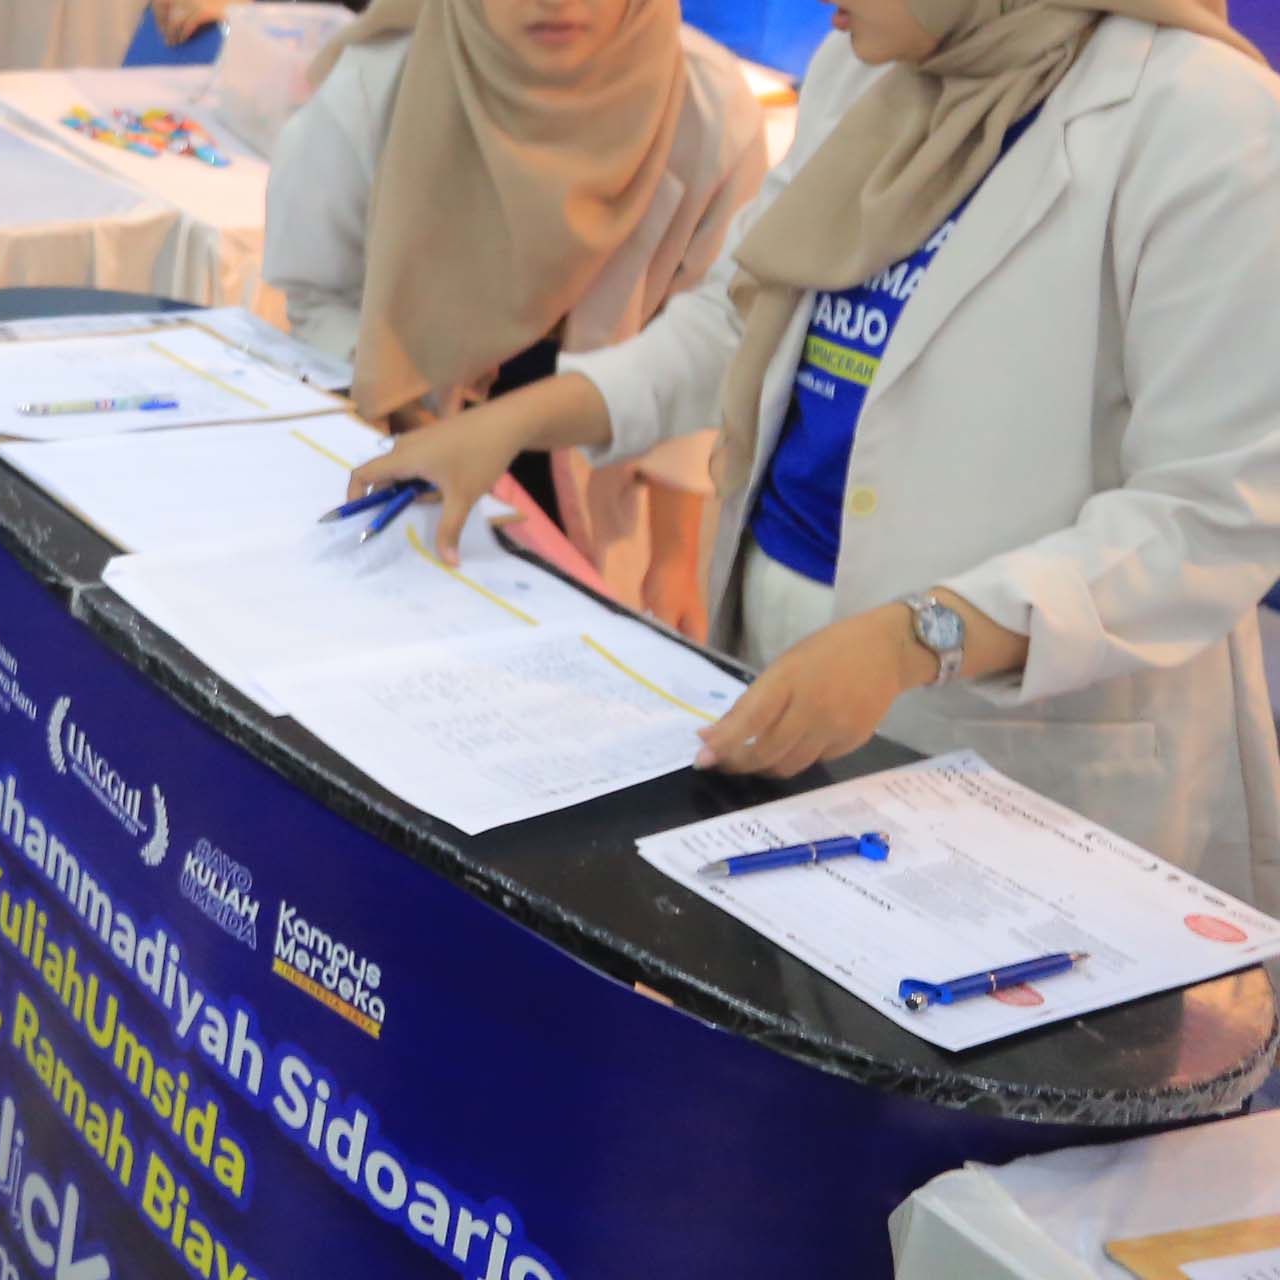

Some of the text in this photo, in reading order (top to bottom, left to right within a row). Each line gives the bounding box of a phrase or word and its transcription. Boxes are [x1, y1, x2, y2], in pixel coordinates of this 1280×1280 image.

[814, 293, 889, 347] ARJO
[183, 850, 261, 924] KULIAH
[274, 930, 386, 1024] Merdeka
[277, 899, 382, 990] Kampus
[11, 992, 134, 1187] Ramah
